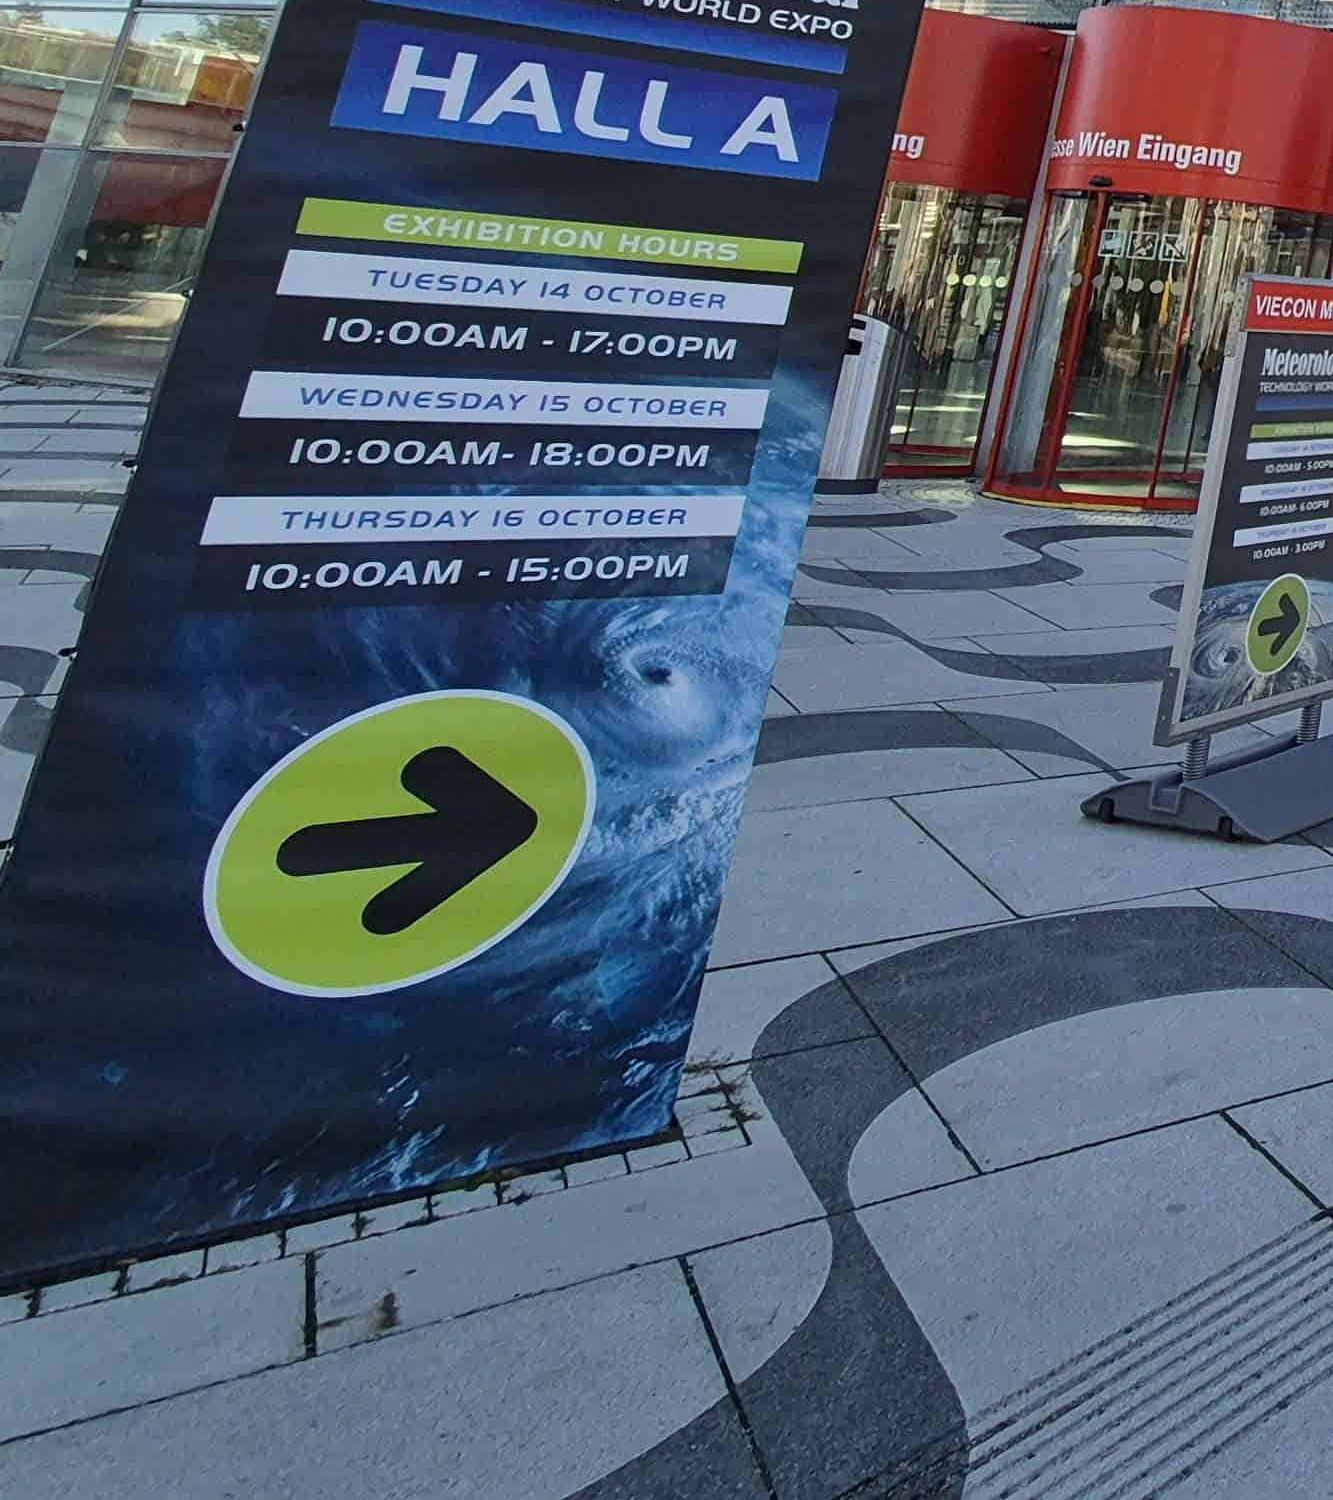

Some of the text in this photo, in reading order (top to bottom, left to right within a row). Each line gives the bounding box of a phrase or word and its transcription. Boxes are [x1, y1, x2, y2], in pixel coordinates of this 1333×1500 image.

[769, 9, 854, 41] EXPO
[381, 44, 800, 163] HALL A
[891, 133, 925, 159] ng
[1078, 131, 1131, 159] Wien
[1137, 134, 1242, 174] Eingang
[383, 212, 740, 263] EXHIBITION HOURS
[367, 268, 728, 310] TUESDAY 14 OCTOBER
[1255, 294, 1318, 319] VIECON
[321, 316, 529, 351] 10:00AM
[568, 330, 738, 362] 17:00PM
[299, 385, 728, 418] WEDNESDAY 15 OCTOBER
[529, 440, 712, 469] 18:00PM
[281, 508, 688, 531] THURSDAY 16 OCTOBER
[245, 558, 463, 592] 10:00AM
[505, 553, 689, 584] 15:00PM
